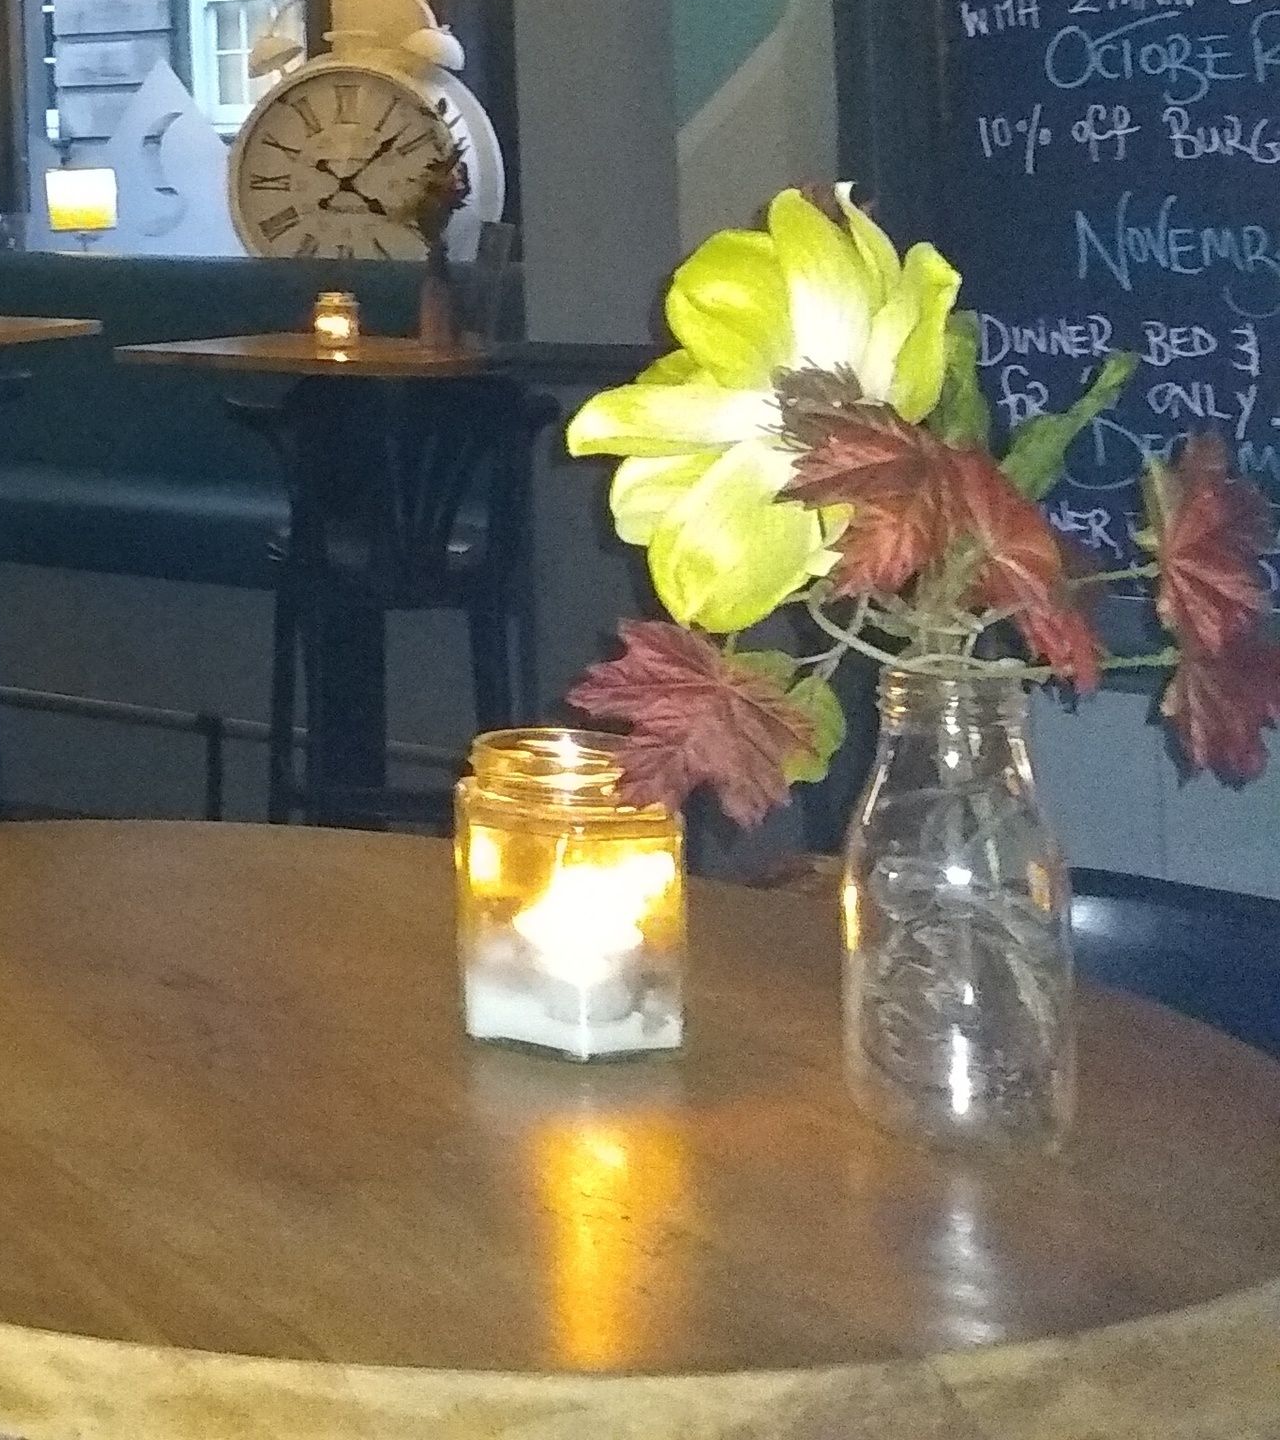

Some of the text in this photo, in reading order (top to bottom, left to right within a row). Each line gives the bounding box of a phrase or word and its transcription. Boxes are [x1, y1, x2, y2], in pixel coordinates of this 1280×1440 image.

[978, 103, 1052, 175] 10%
[976, 312, 1112, 367] DINNER
[1140, 320, 1218, 367] BED
[1145, 382, 1258, 440] ONLY
